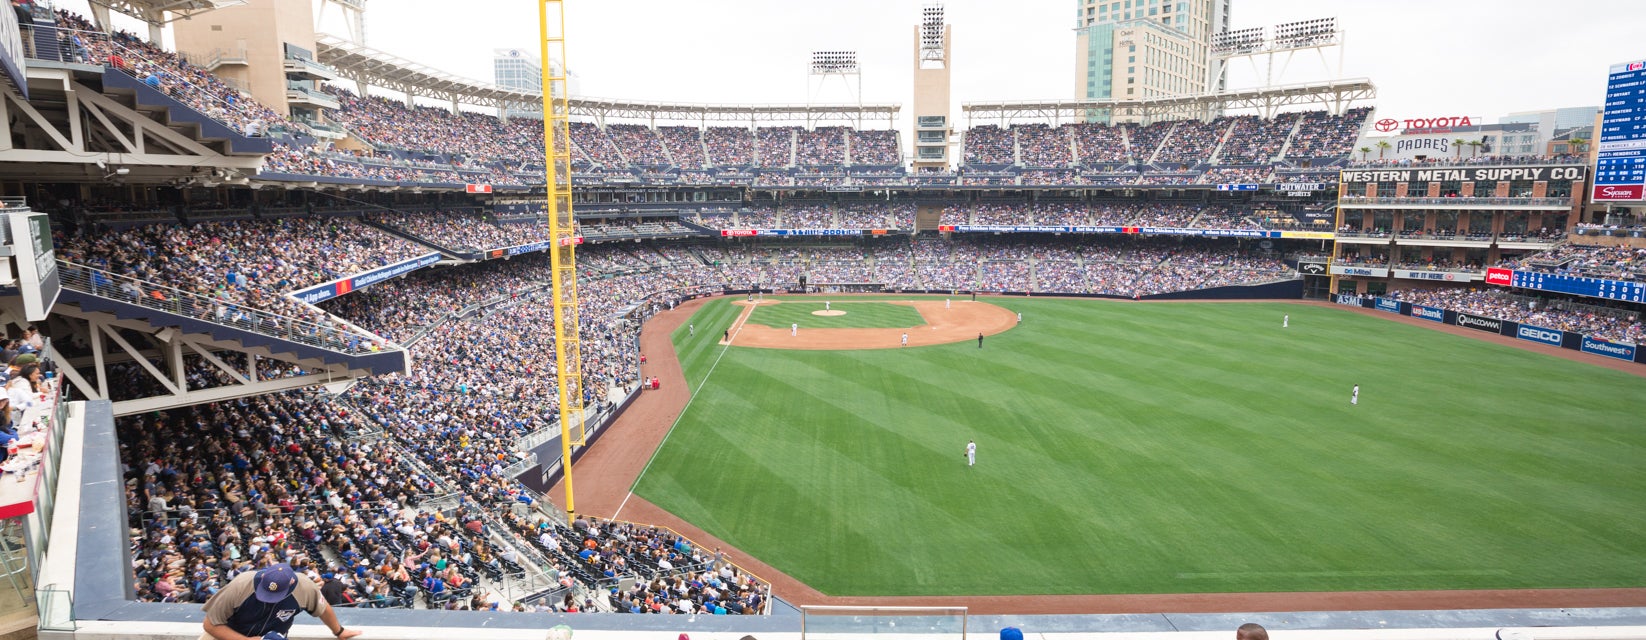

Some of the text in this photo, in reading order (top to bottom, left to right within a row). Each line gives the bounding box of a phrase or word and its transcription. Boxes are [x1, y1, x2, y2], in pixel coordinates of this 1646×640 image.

[1404, 116, 1472, 129] TOYOTA
[1397, 138, 1448, 153] PADRES
[1343, 168, 1583, 182] WESTERN METAL SUPPLY CO.
[1602, 187, 1632, 197] Sycuan
[1304, 263, 1324, 272] Callaway
[1337, 295, 1362, 306] ASML
[1422, 308, 1442, 319] bank
[1459, 315, 1499, 329] QUALCOMM
[1520, 327, 1560, 342] GEICO
[1585, 340, 1626, 354] Southwest
